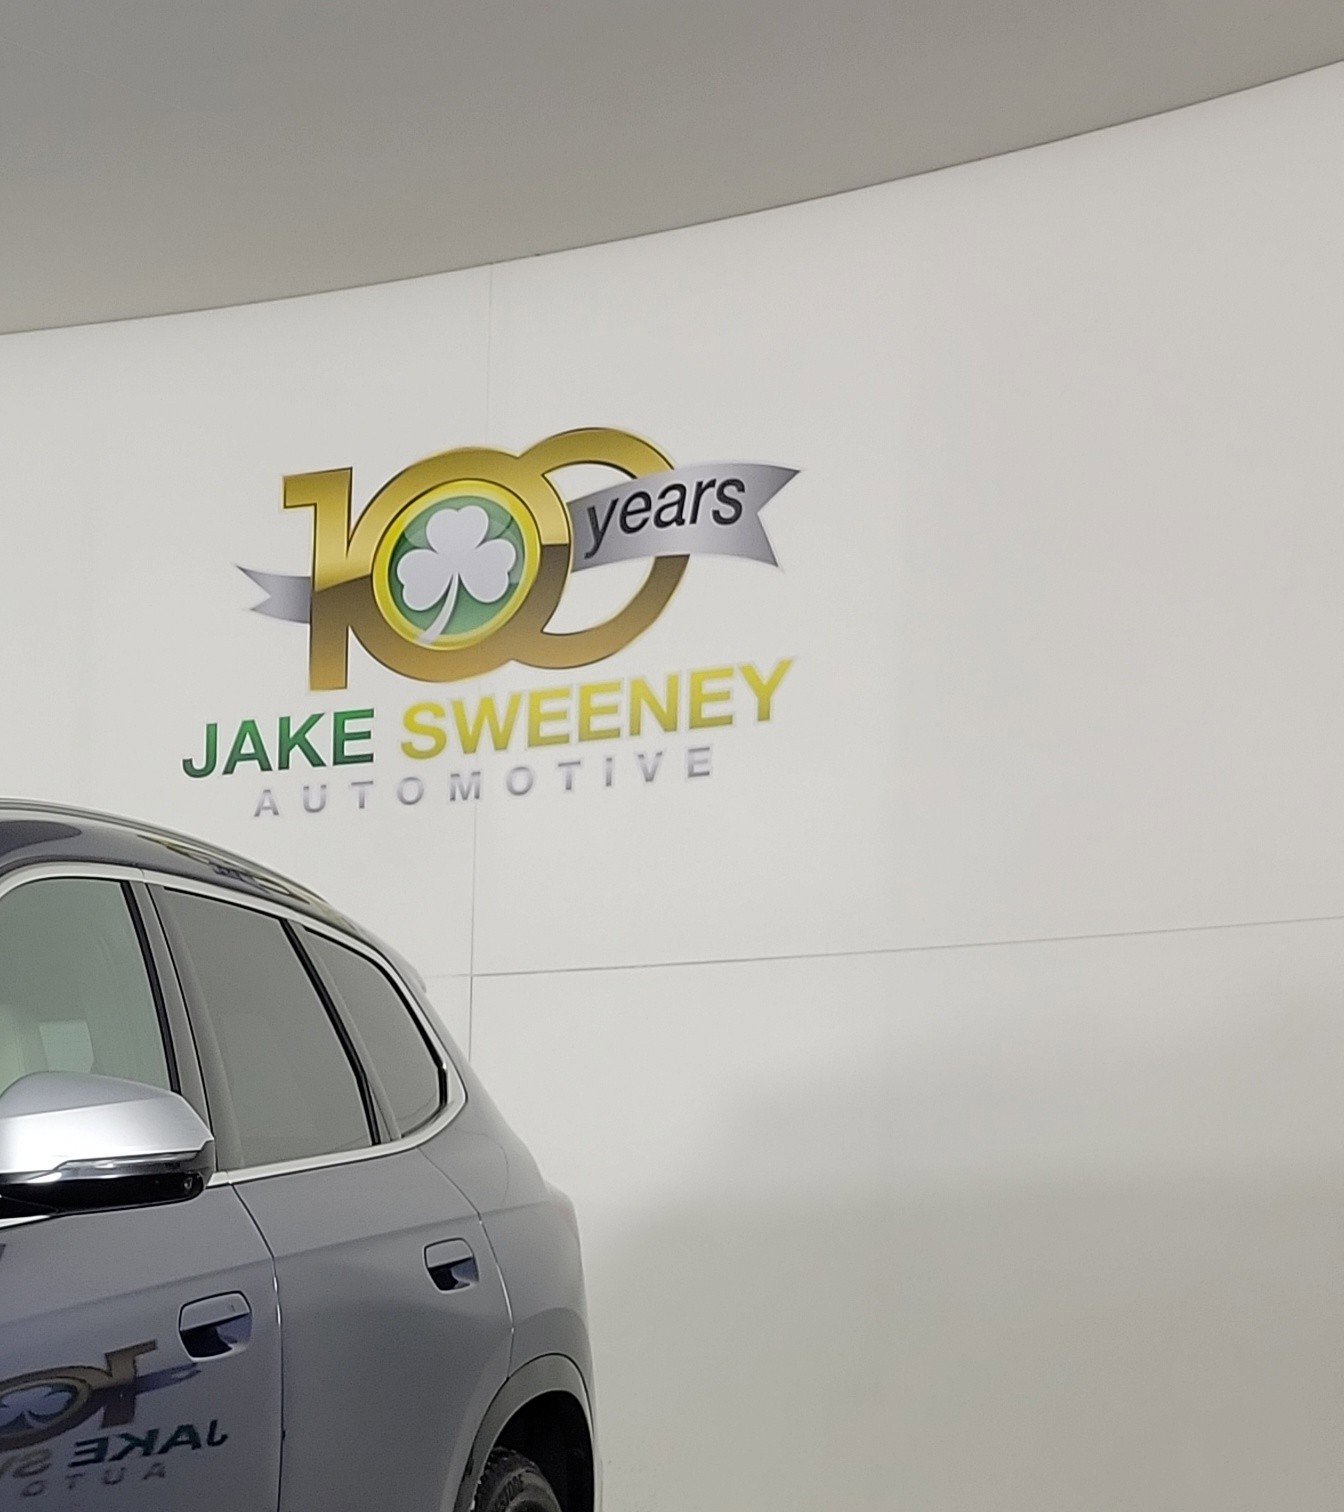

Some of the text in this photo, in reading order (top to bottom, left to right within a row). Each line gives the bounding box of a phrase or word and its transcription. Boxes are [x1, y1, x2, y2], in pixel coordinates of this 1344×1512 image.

[584, 476, 747, 559] years
[182, 657, 794, 778] JAKE SWEENEY
[253, 747, 712, 818] AUTOMOTIVE
